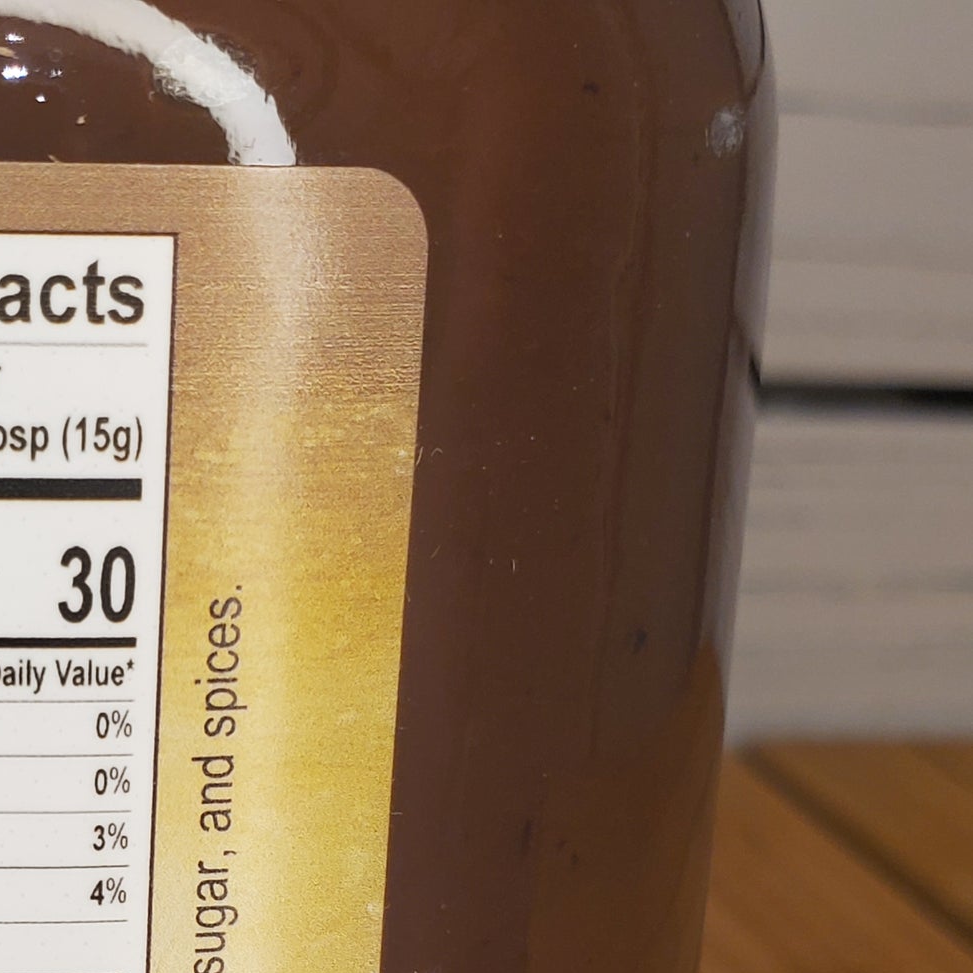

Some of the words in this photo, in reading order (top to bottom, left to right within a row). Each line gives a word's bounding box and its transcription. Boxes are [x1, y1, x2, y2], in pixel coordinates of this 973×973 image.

[62, 417, 142, 462] (15g)
[58, 546, 135, 623] 30
[194, 585, 247, 737] spices.
[96, 710, 132, 739] 0%
[95, 767, 130, 795] 0%
[191, 755, 234, 832] and
[93, 823, 128, 851] 3%
[90, 877, 126, 905] 4%
